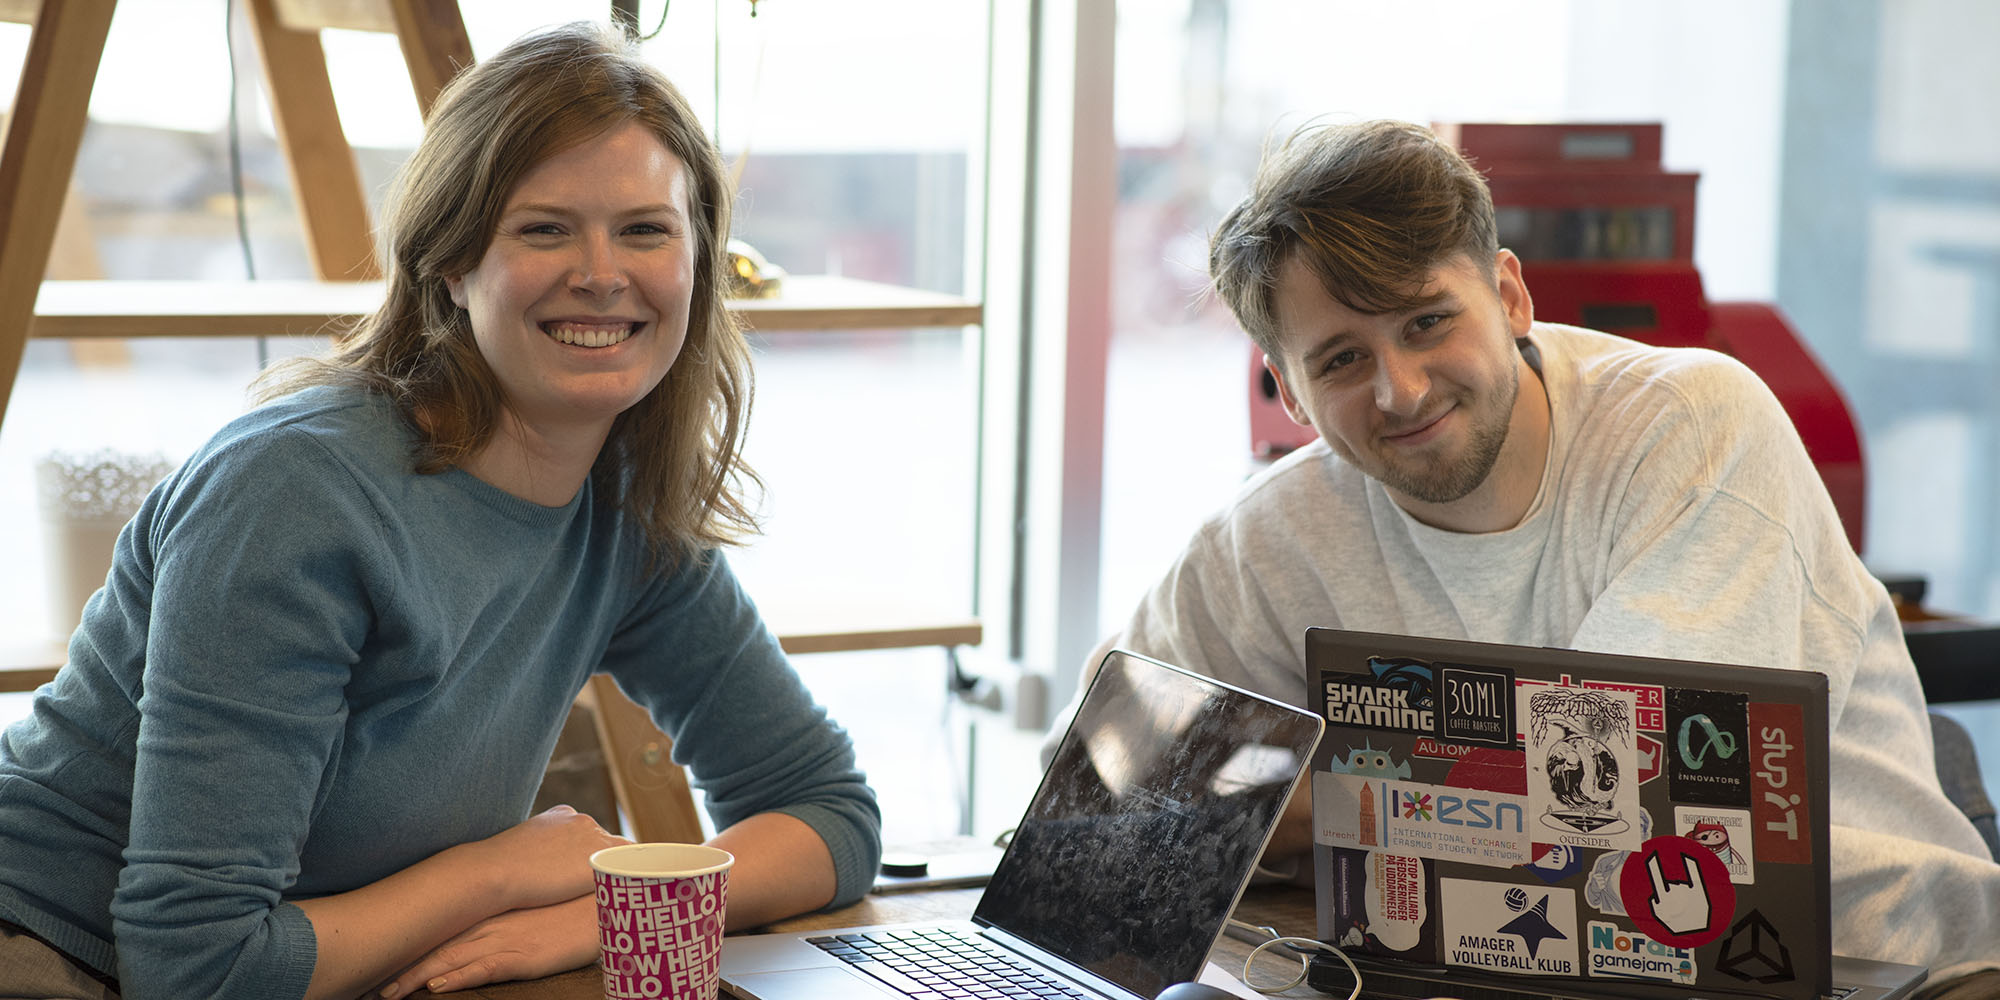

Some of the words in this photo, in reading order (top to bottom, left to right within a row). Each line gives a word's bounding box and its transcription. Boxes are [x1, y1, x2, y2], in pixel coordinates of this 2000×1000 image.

[1326, 682, 1410, 709] SHARK
[1447, 679, 1502, 719] 30ML
[1327, 701, 1435, 732] GAMING
[1449, 718, 1471, 730] COFFEE
[1472, 721, 1502, 733] ROASTERS
[1418, 741, 1477, 756] AUTOM
[1322, 829, 1356, 841] Utrecht
[1393, 827, 1466, 844] INTERNATIONAL
[1472, 837, 1518, 850] EXCHANGE
[1559, 834, 1613, 849] OUTSIDER
[1393, 837, 1433, 850] ERASMUS
[1438, 843, 1478, 857] STUDENT
[1483, 848, 1525, 861] NETWORK
[1407, 857, 1418, 879] STOP
[611, 873, 716, 910] FELLOW
[1386, 867, 1397, 921] UDDANNELSE
[1396, 856, 1408, 921] NEDSKÆRINGER
[635, 893, 717, 931] HELLO
[1459, 935, 1516, 953] AMAGER
[1452, 950, 1533, 970] VOLLEYBALL
[1537, 958, 1572, 974] KLUB
[1593, 954, 1674, 973] gamejam
